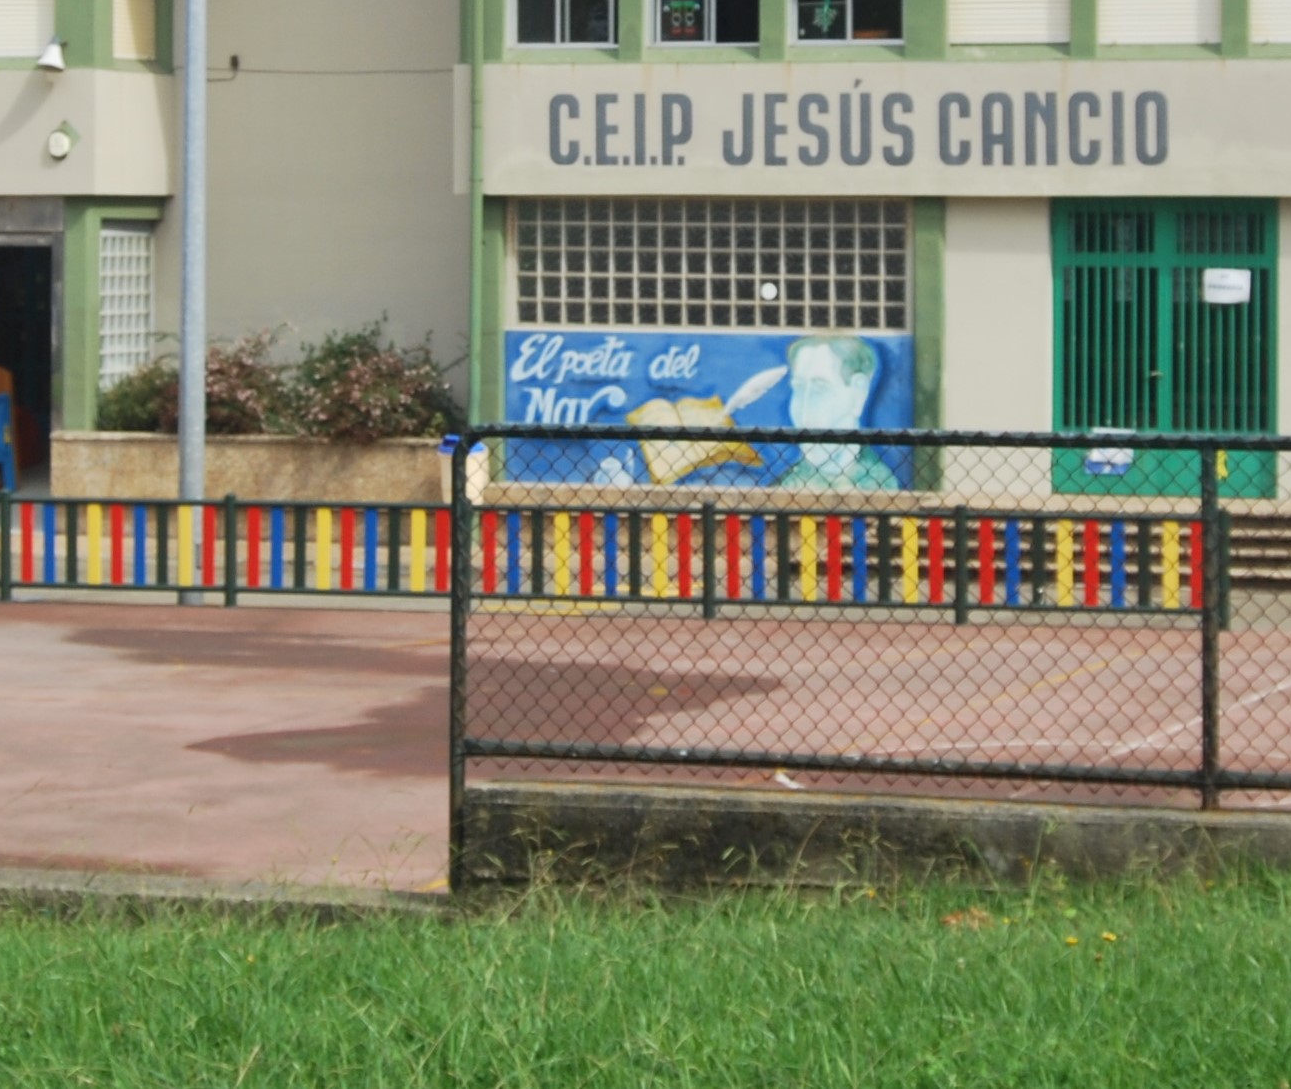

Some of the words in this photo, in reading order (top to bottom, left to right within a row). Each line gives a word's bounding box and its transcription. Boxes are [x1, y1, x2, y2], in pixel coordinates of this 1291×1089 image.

[548, 92, 694, 167] C.E.I.P.
[721, 79, 916, 167] JESÚS
[936, 90, 1170, 167] CANCIO
[510, 333, 565, 383] El
[553, 335, 635, 384] poeta
[648, 343, 701, 381] del
[522, 385, 628, 426] Mar
